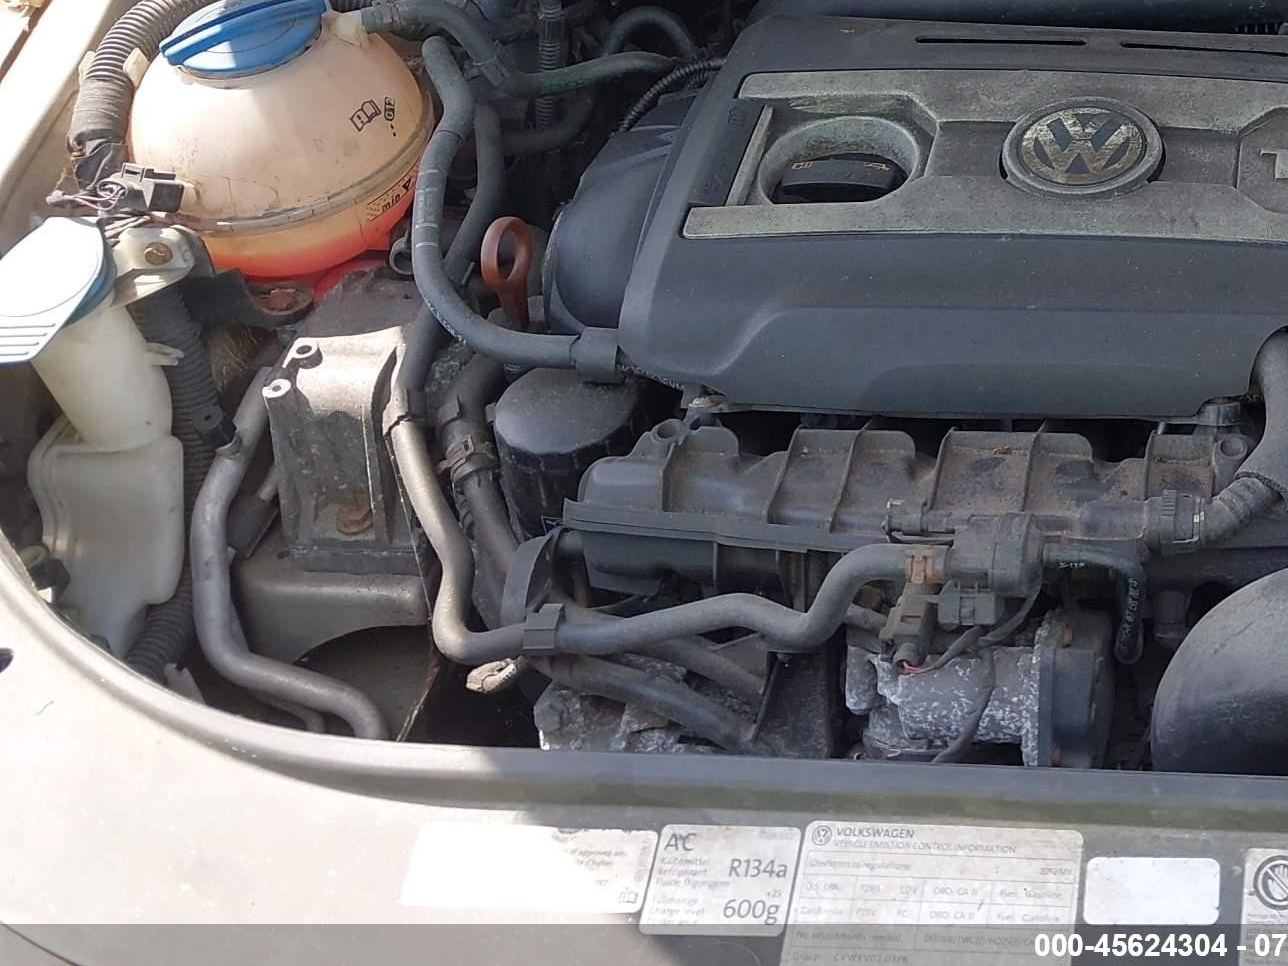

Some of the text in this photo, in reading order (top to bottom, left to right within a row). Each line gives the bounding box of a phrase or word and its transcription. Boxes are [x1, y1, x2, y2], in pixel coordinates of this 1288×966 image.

[382, 193, 401, 213] min
[836, 826, 915, 839] VOLKSWAGEN
[728, 858, 788, 878] R134a
[723, 898, 780, 925] 600g
